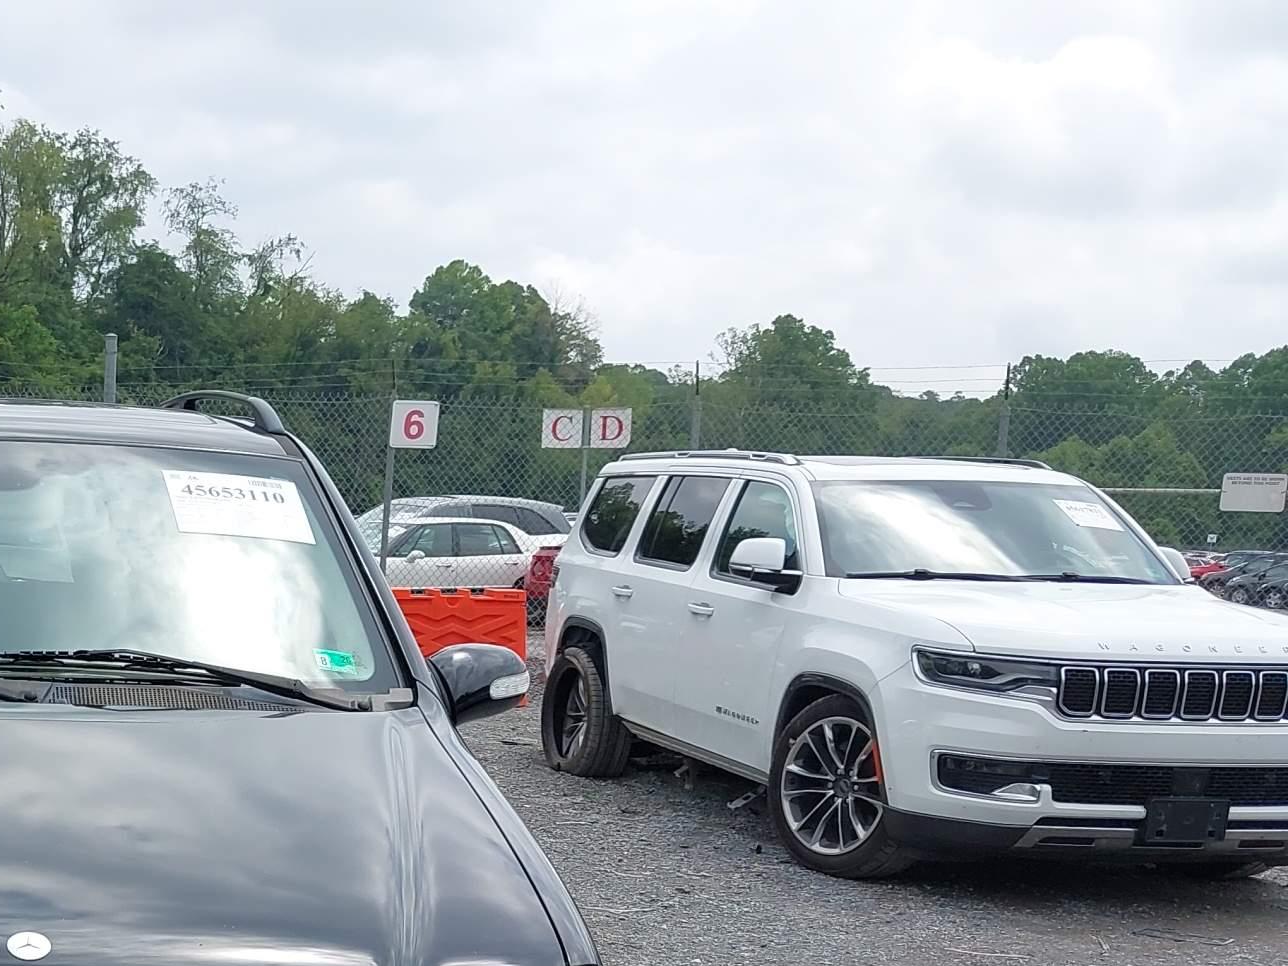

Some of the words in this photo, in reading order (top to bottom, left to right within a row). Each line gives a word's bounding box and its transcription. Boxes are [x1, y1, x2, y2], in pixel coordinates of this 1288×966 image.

[403, 409, 425, 440] 6
[551, 415, 573, 442] C
[599, 415, 624, 441] D
[181, 484, 285, 504] 45653110
